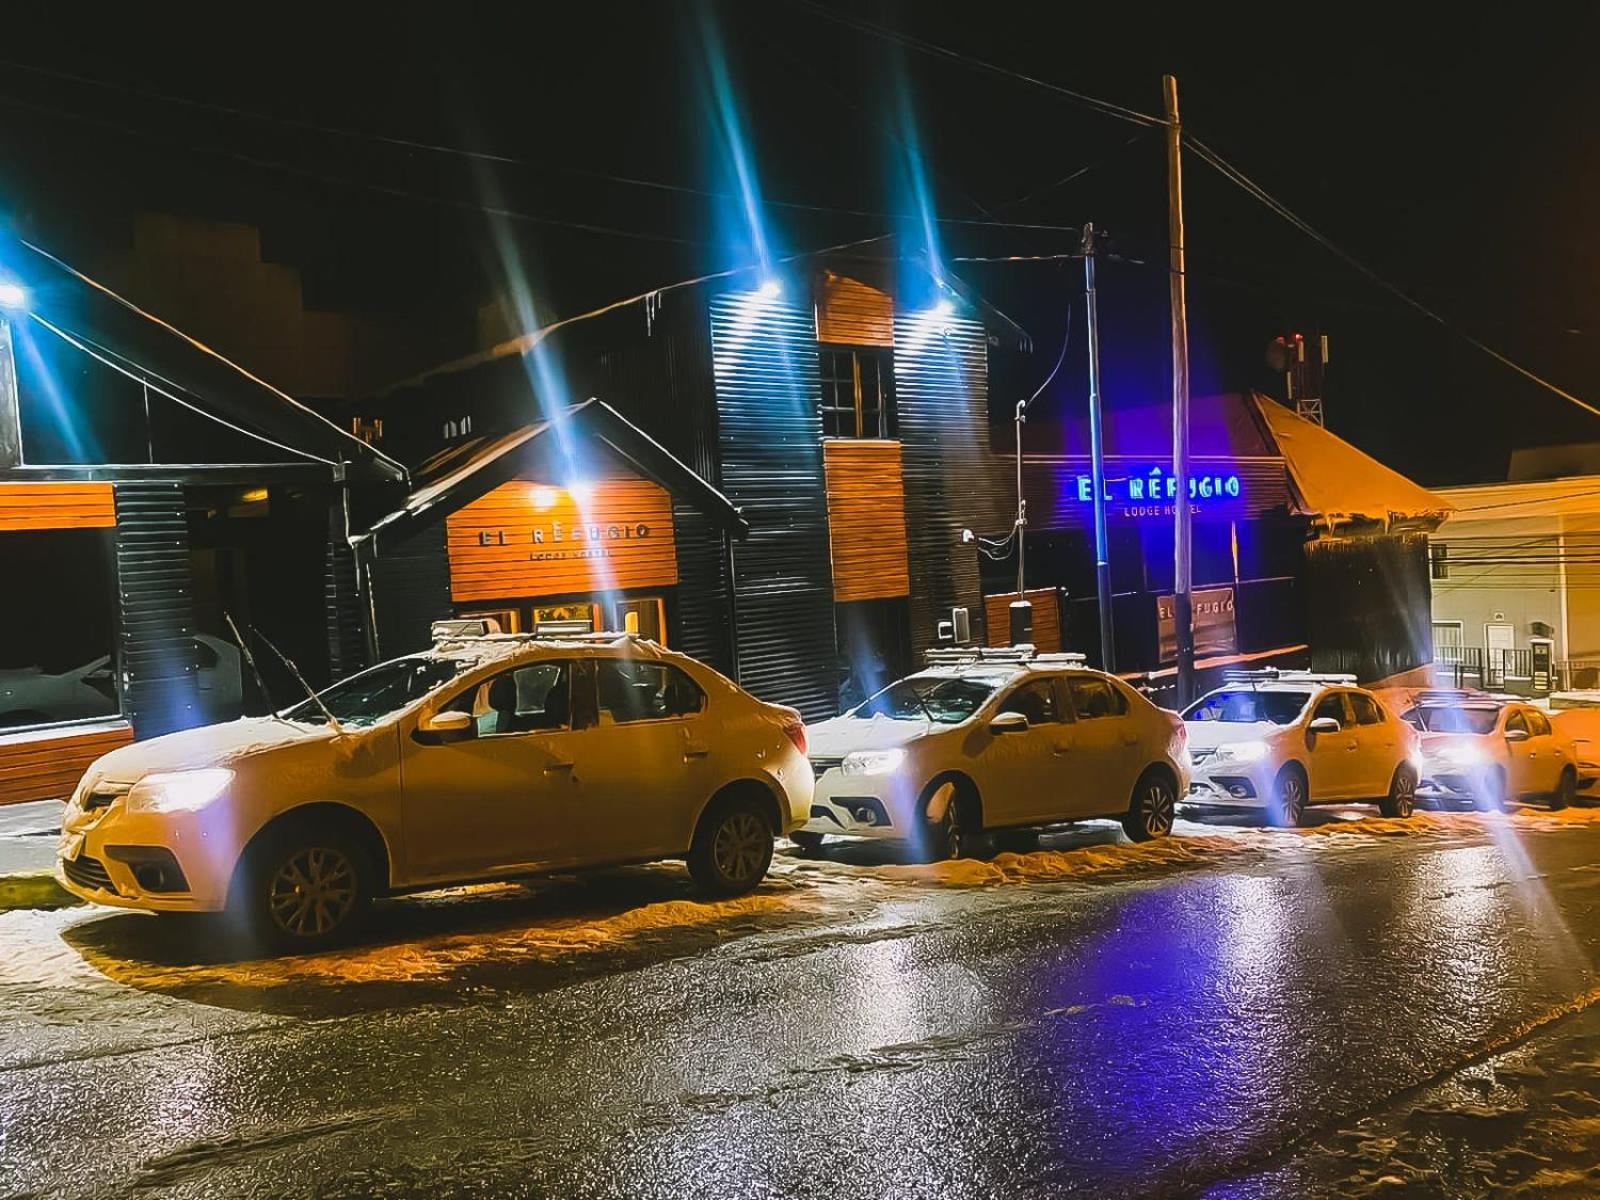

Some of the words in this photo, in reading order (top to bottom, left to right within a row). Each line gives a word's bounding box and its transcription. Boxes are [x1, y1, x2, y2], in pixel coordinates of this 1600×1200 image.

[1077, 475, 1113, 501] EL
[1124, 506, 1161, 517] LODGE
[1164, 505, 1202, 516] HOEL
[1159, 606, 1173, 619] EL
